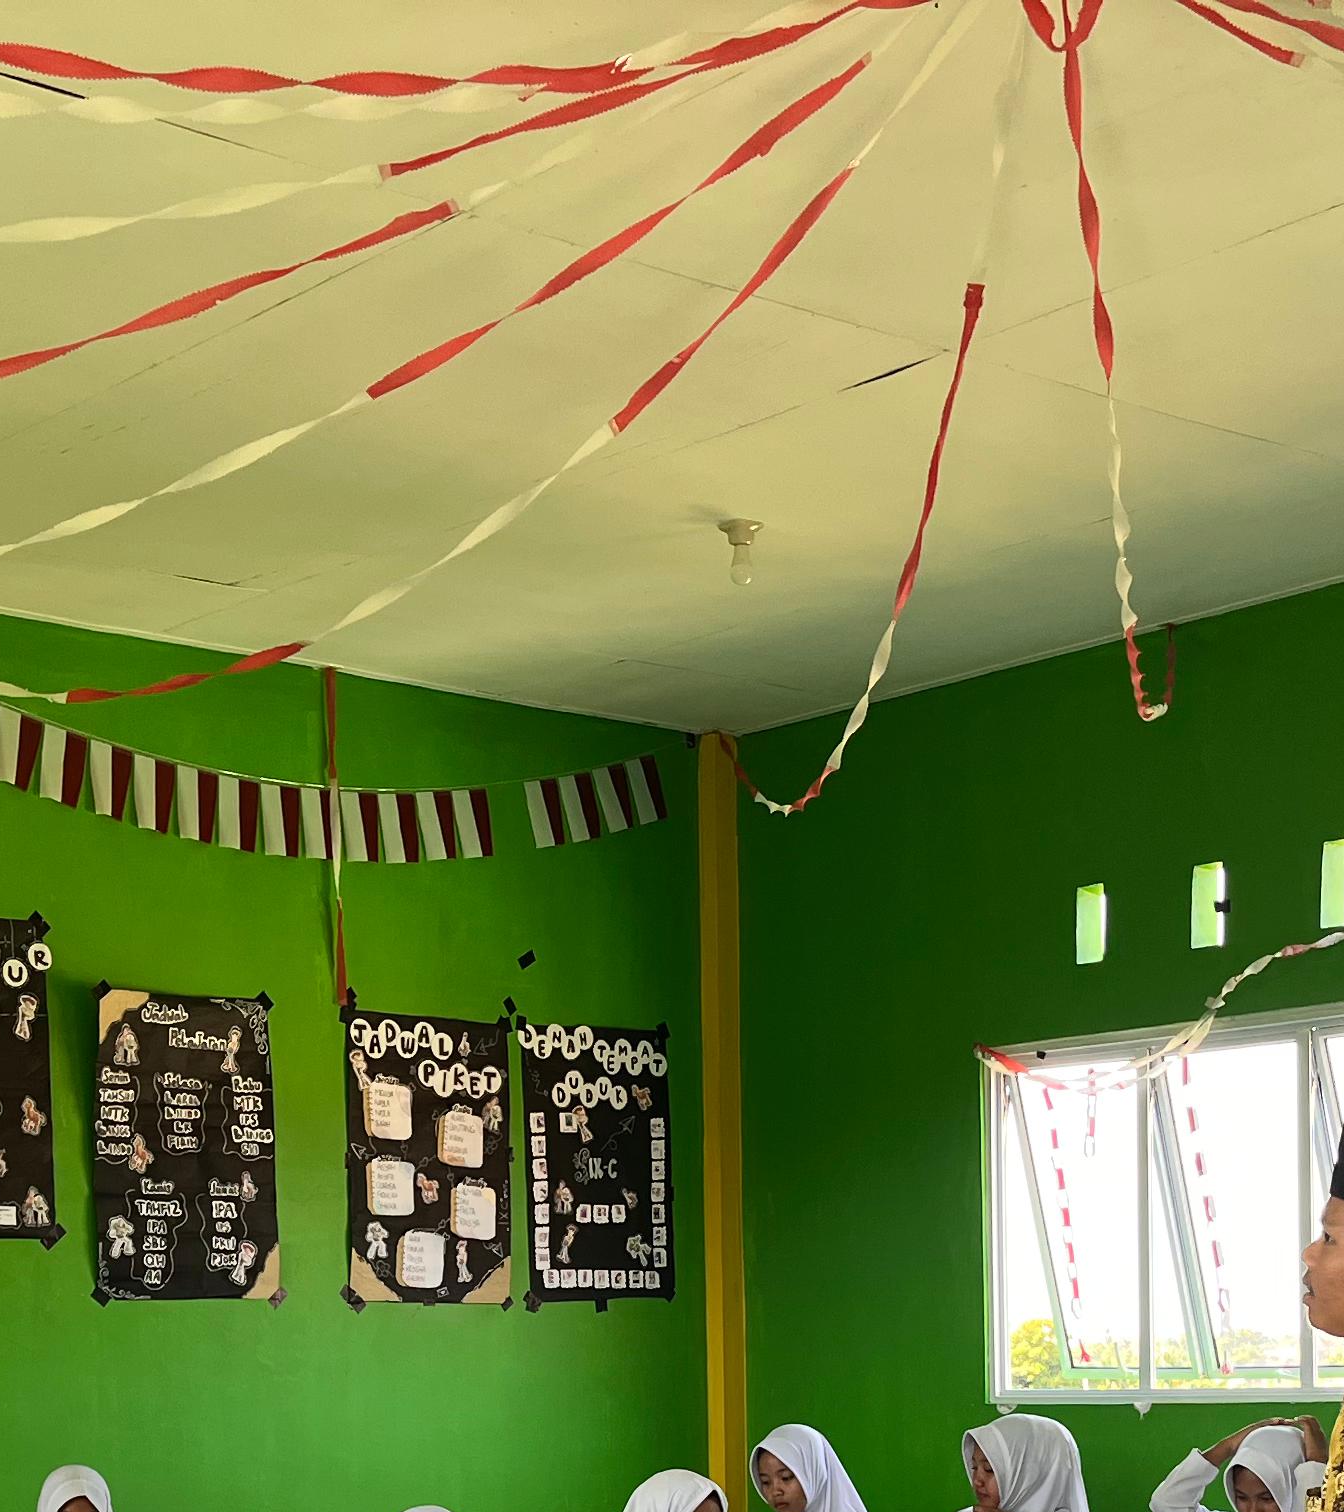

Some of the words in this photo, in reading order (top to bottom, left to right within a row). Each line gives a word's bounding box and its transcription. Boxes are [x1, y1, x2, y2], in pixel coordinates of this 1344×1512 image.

[353, 1021, 453, 1055] JADWAL
[523, 1030, 589, 1055] DENAH
[596, 1044, 665, 1071] TEMPAT
[422, 1063, 501, 1095] PIKET
[556, 1080, 624, 1105] DUDUK
